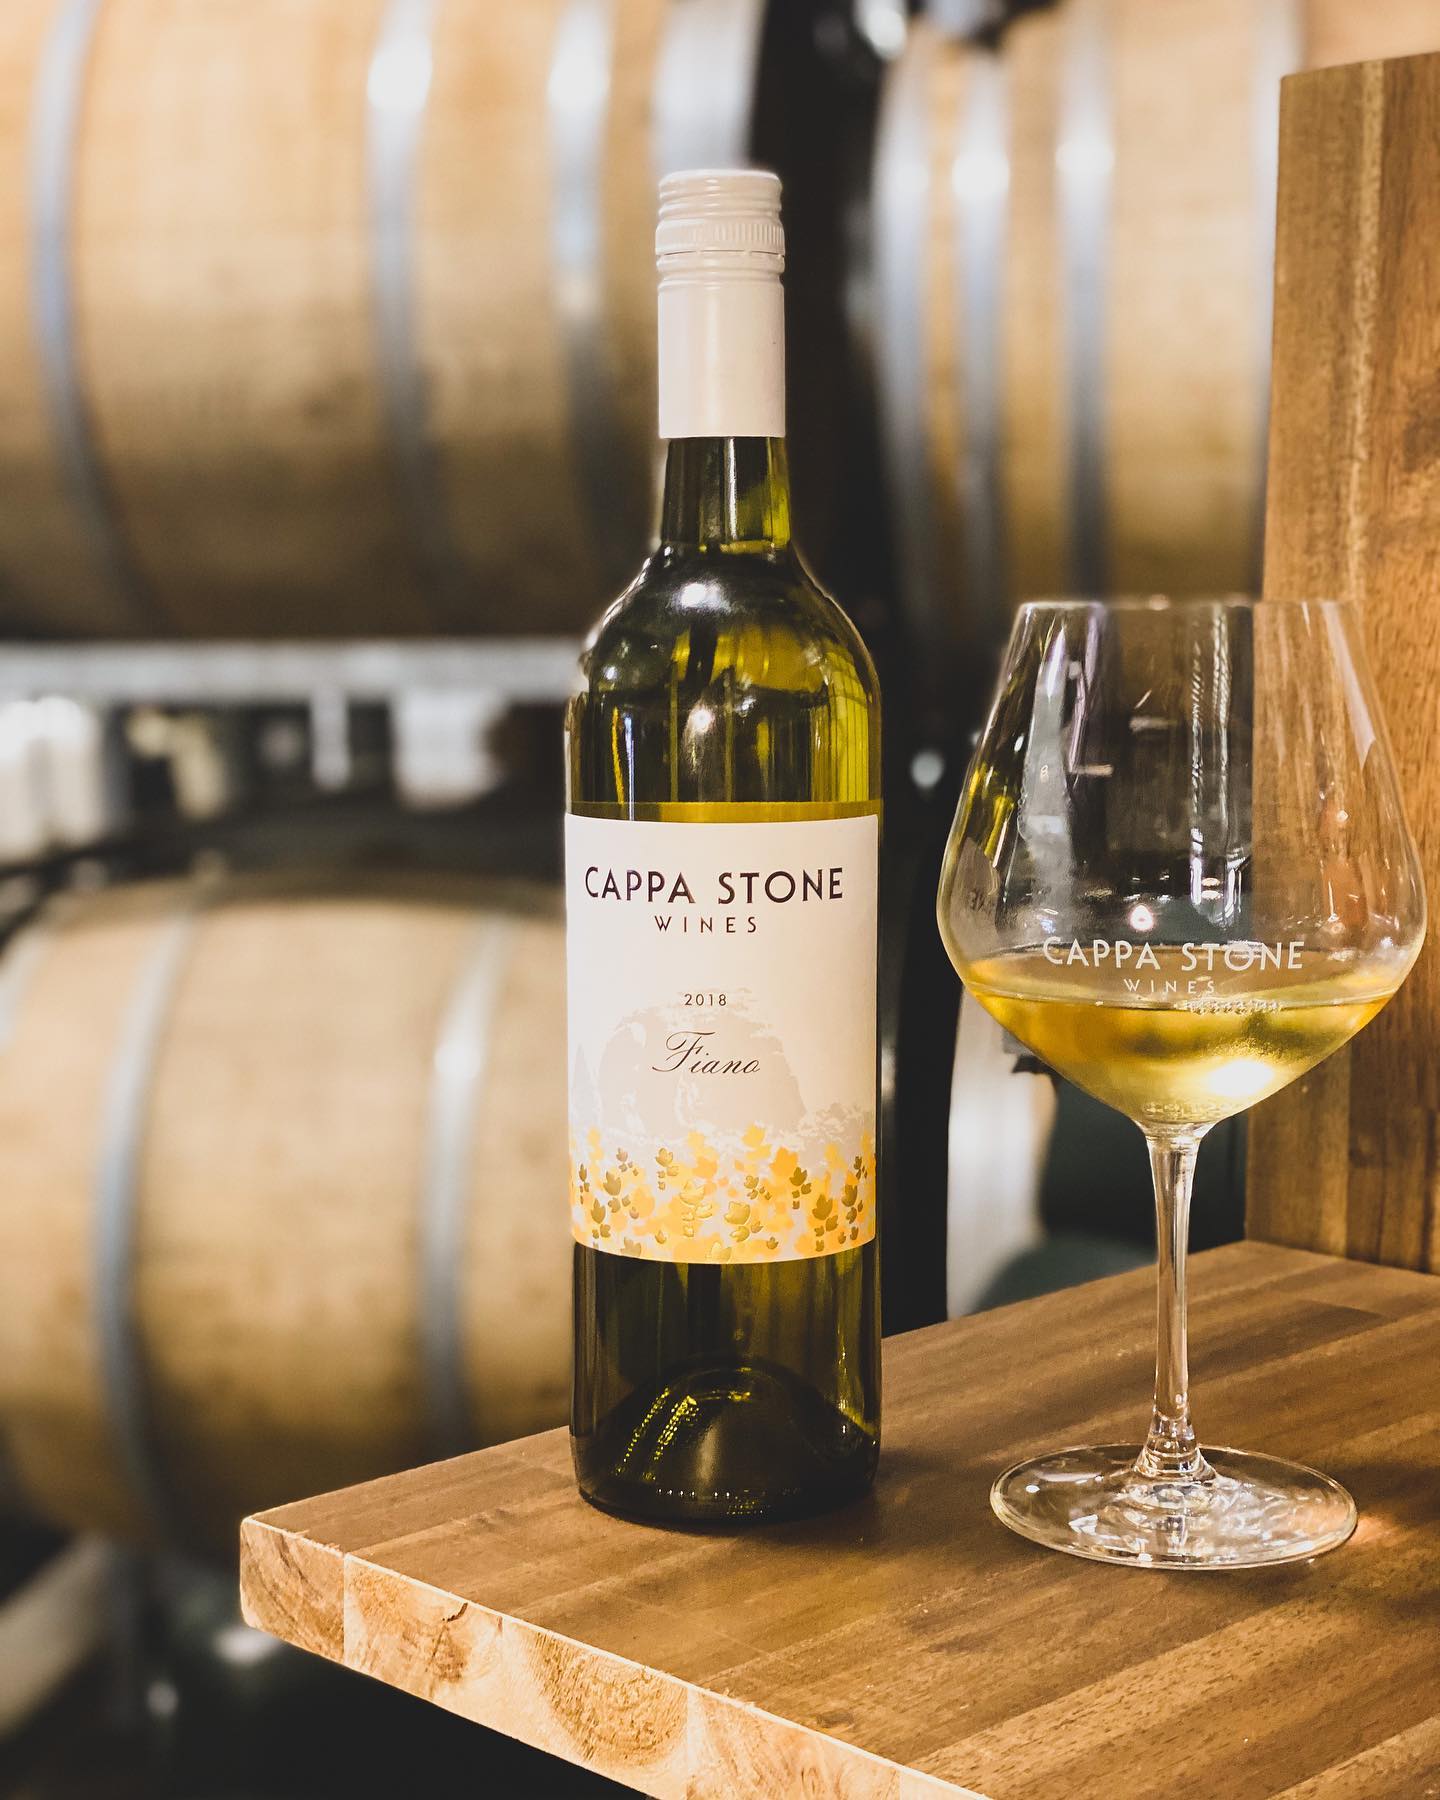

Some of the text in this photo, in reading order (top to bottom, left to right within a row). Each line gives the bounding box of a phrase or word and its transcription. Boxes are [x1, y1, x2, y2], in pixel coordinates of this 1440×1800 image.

[585, 866, 844, 905] CAPPA STONE
[654, 915, 758, 933] WINES
[1042, 936, 1305, 972] CAPPA STONE
[683, 993, 728, 1007] 2018
[1123, 978, 1215, 995] WINES
[651, 1030, 761, 1075] Fiano
